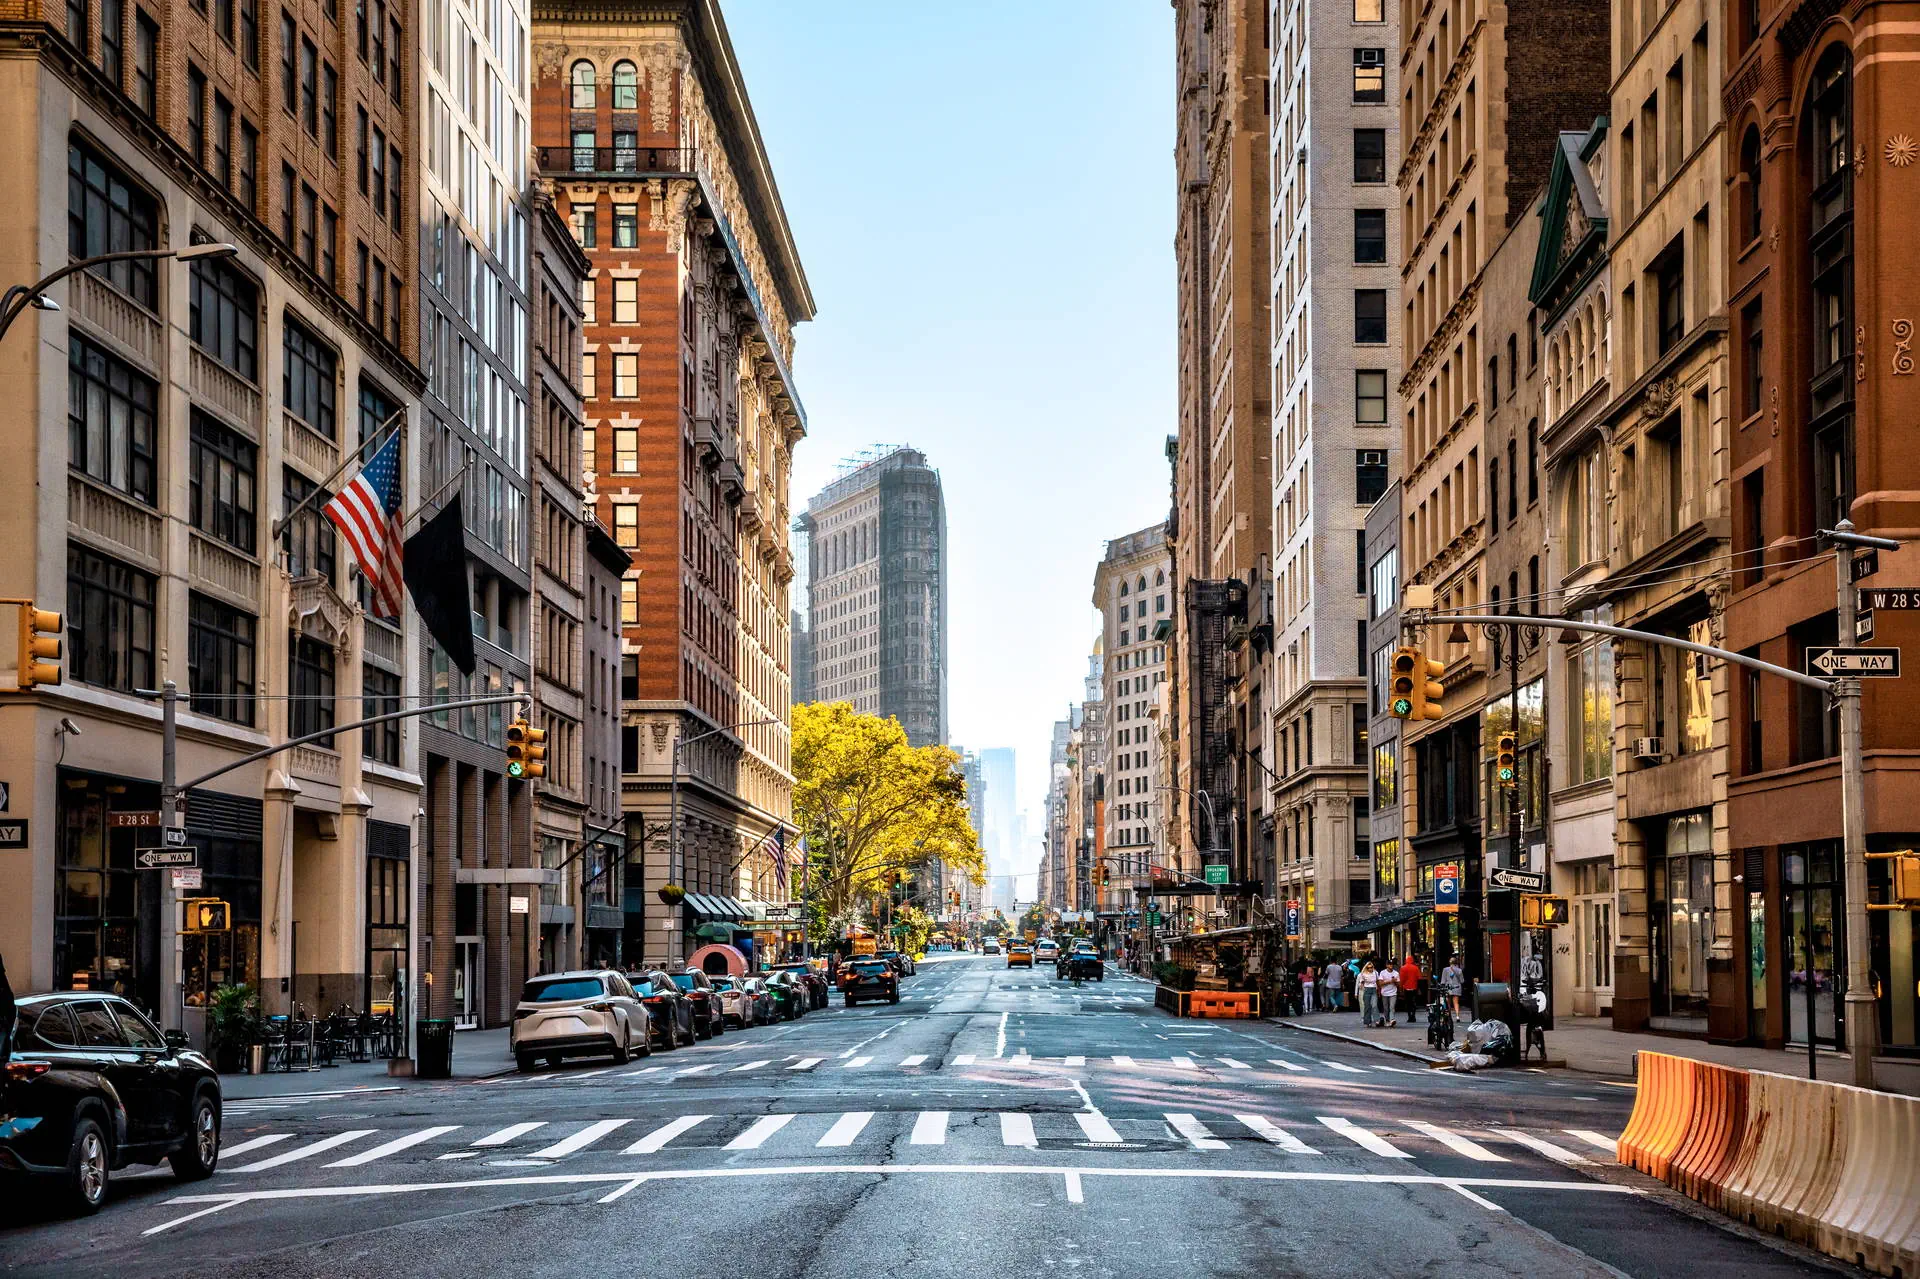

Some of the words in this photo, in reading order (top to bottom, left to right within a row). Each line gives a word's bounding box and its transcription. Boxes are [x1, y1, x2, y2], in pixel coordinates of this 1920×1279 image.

[1874, 594, 1886, 608] W
[1892, 593, 1907, 608] 28
[1913, 593, 1920, 608] S
[1821, 656, 1848, 668] ONE
[1860, 656, 1888, 668] WAY
[119, 815, 124, 825] E
[126, 815, 137, 825] 28
[140, 815, 149, 825] St
[0, 828, 15, 840] AY
[144, 854, 161, 863] ONE
[169, 853, 188, 862] WAY
[1498, 873, 1513, 883] ONE
[1520, 876, 1537, 886] WAY
